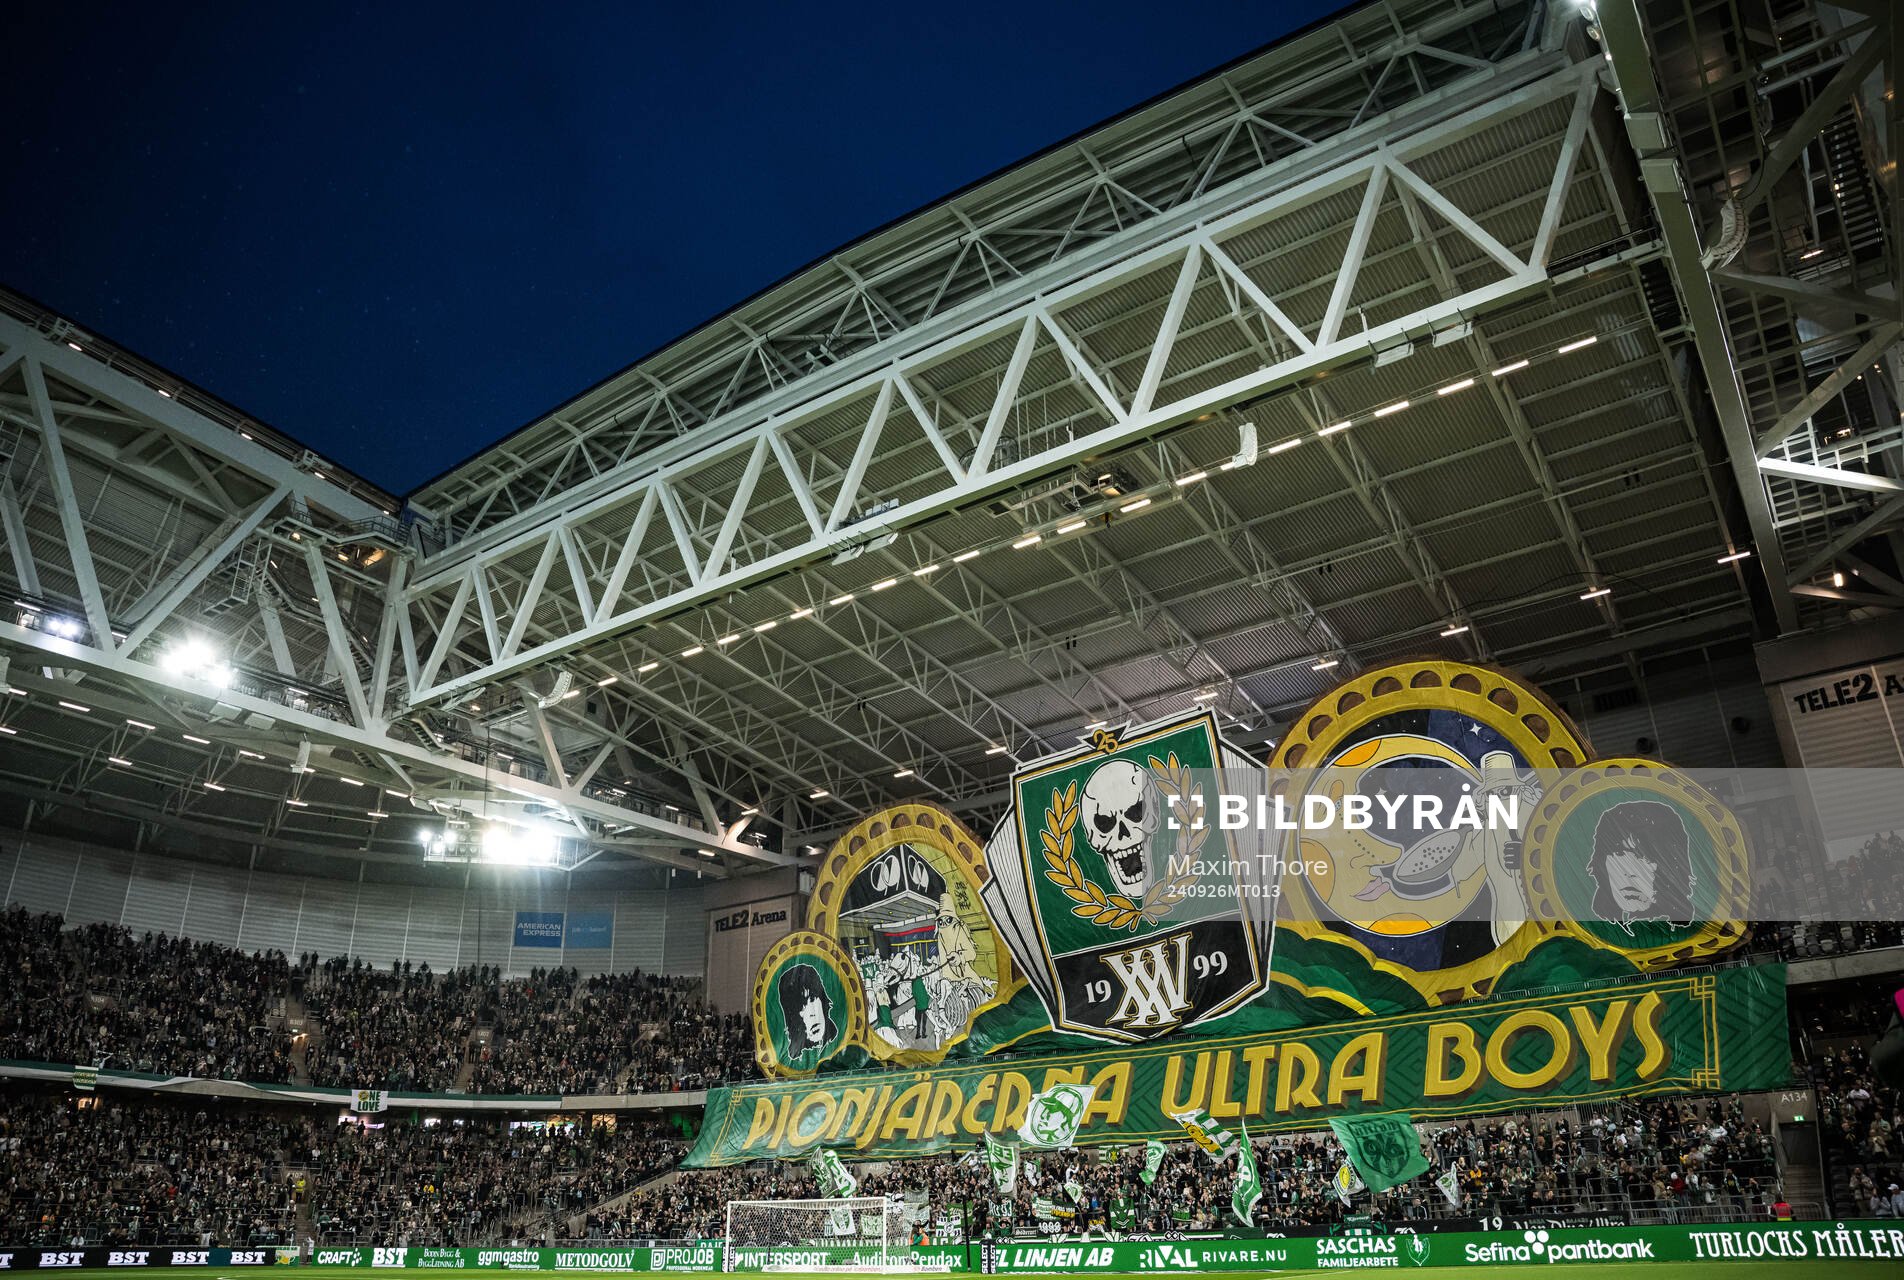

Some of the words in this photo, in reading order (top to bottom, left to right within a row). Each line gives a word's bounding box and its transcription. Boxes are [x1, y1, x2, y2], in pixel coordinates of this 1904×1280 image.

[1793, 673, 1879, 714] TELE2
[1884, 674, 1904, 697] A
[1093, 728, 1119, 754] 25
[517, 922, 561, 930] AMERICAN
[714, 909, 749, 933] TELE2
[751, 909, 787, 927] Arena
[522, 929, 561, 937] EXPRESS
[1083, 979, 1112, 1004] 19
[1192, 950, 1228, 980] 99
[1160, 1031, 1386, 1118] ULTRA
[1423, 990, 1667, 1097] BOYS
[357, 1100, 380, 1112] LOVE
[1781, 1091, 1808, 1103] A134
[1315, 1236, 1397, 1255] SASCHAS
[1464, 1242, 1532, 1263] Sefina
[1547, 1238, 1656, 1264] pantbank
[1688, 1229, 1808, 1258] TURLOCKS
[39, 1252, 85, 1266] BST
[107, 1251, 150, 1265] BST
[170, 1251, 210, 1264] BST
[230, 1251, 266, 1263] BST
[317, 1251, 353, 1265] CRAFT
[372, 1247, 408, 1266] BST
[455, 1249, 461, 1258] &
[478, 1248, 540, 1266] ggmgastro
[554, 1249, 635, 1268] METODGOLV
[666, 1248, 715, 1265] PROJOB
[744, 1251, 830, 1268] INTERSPORT
[911, 1250, 962, 1268] Pendax
[981, 1244, 989, 1274] SELECT
[1013, 1247, 1084, 1268] LINJEN
[1084, 1247, 1115, 1267] AB
[1139, 1244, 1199, 1268] RIVAL
[1202, 1249, 1287, 1263] RIVARE.NU
[1317, 1256, 1399, 1268] FAMILJEARBETE
[455, 1258, 465, 1268] AB
